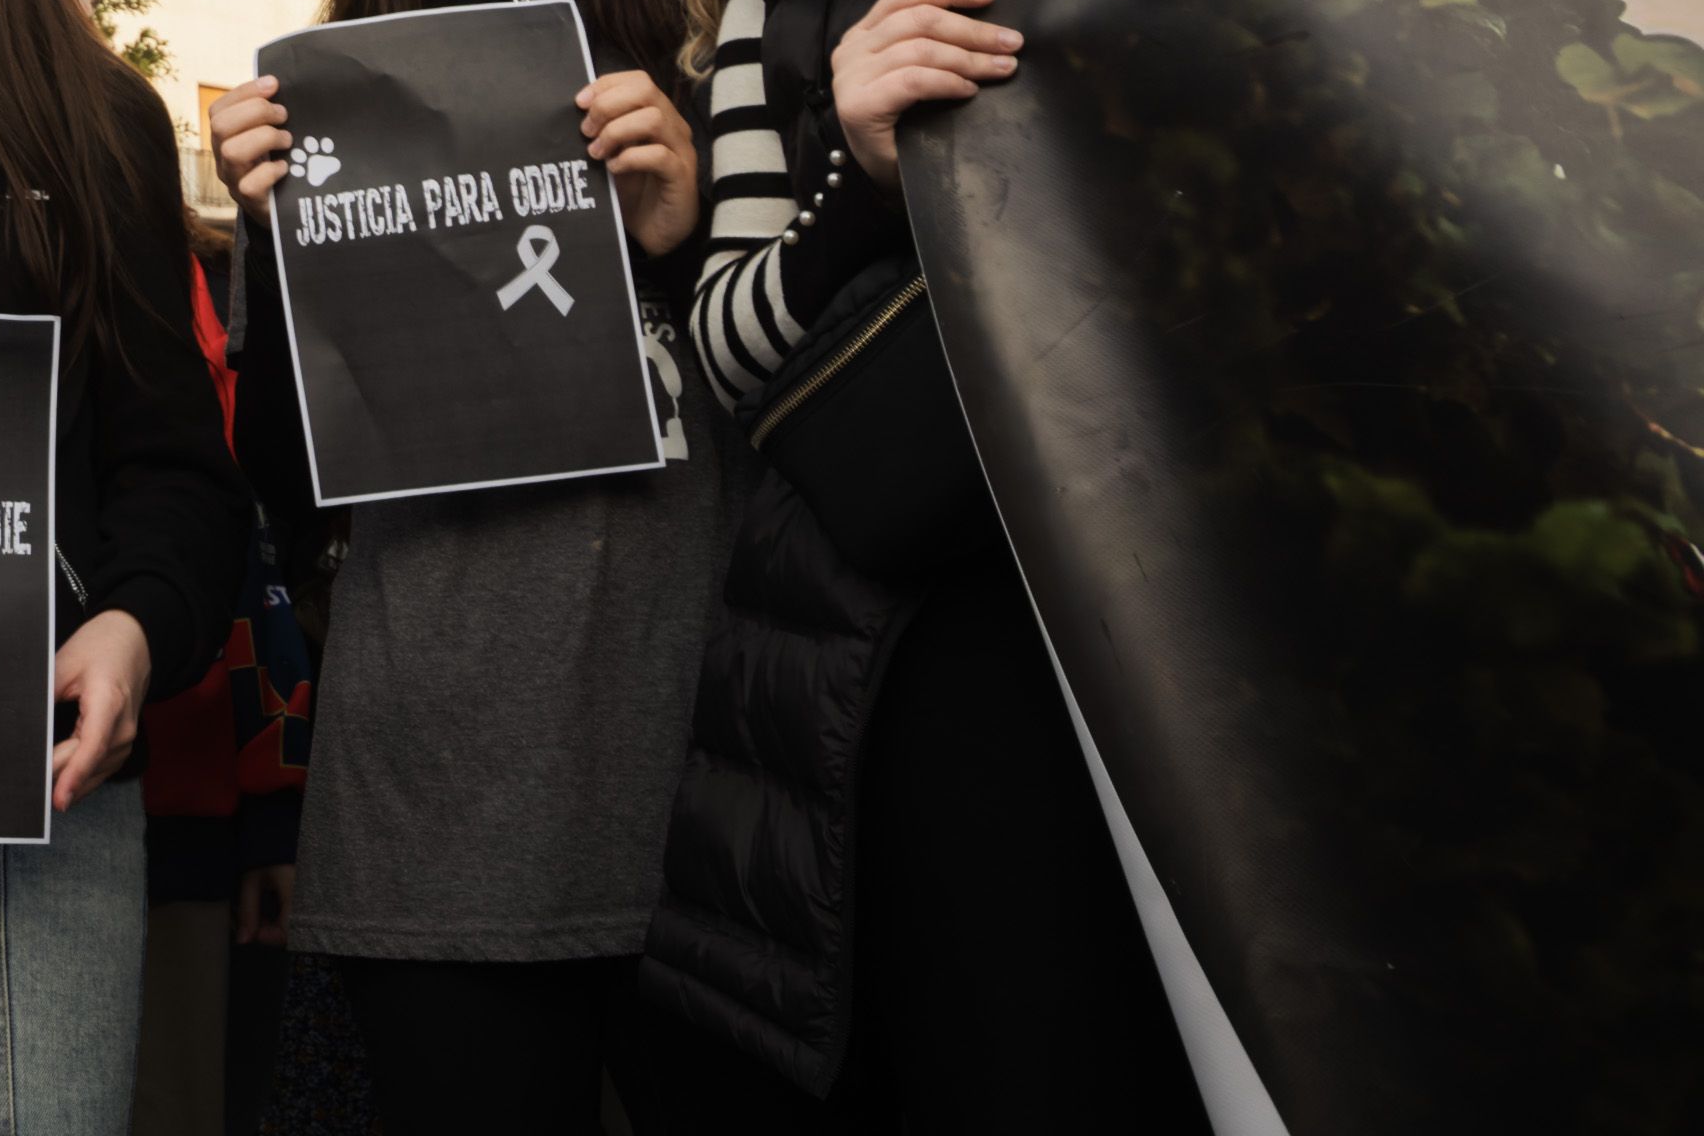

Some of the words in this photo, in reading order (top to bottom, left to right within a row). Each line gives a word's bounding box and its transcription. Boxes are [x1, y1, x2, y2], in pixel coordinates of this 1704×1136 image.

[296, 182, 417, 247] JUSTICIA
[421, 171, 504, 229] PARA
[508, 159, 596, 217] ODDIE
